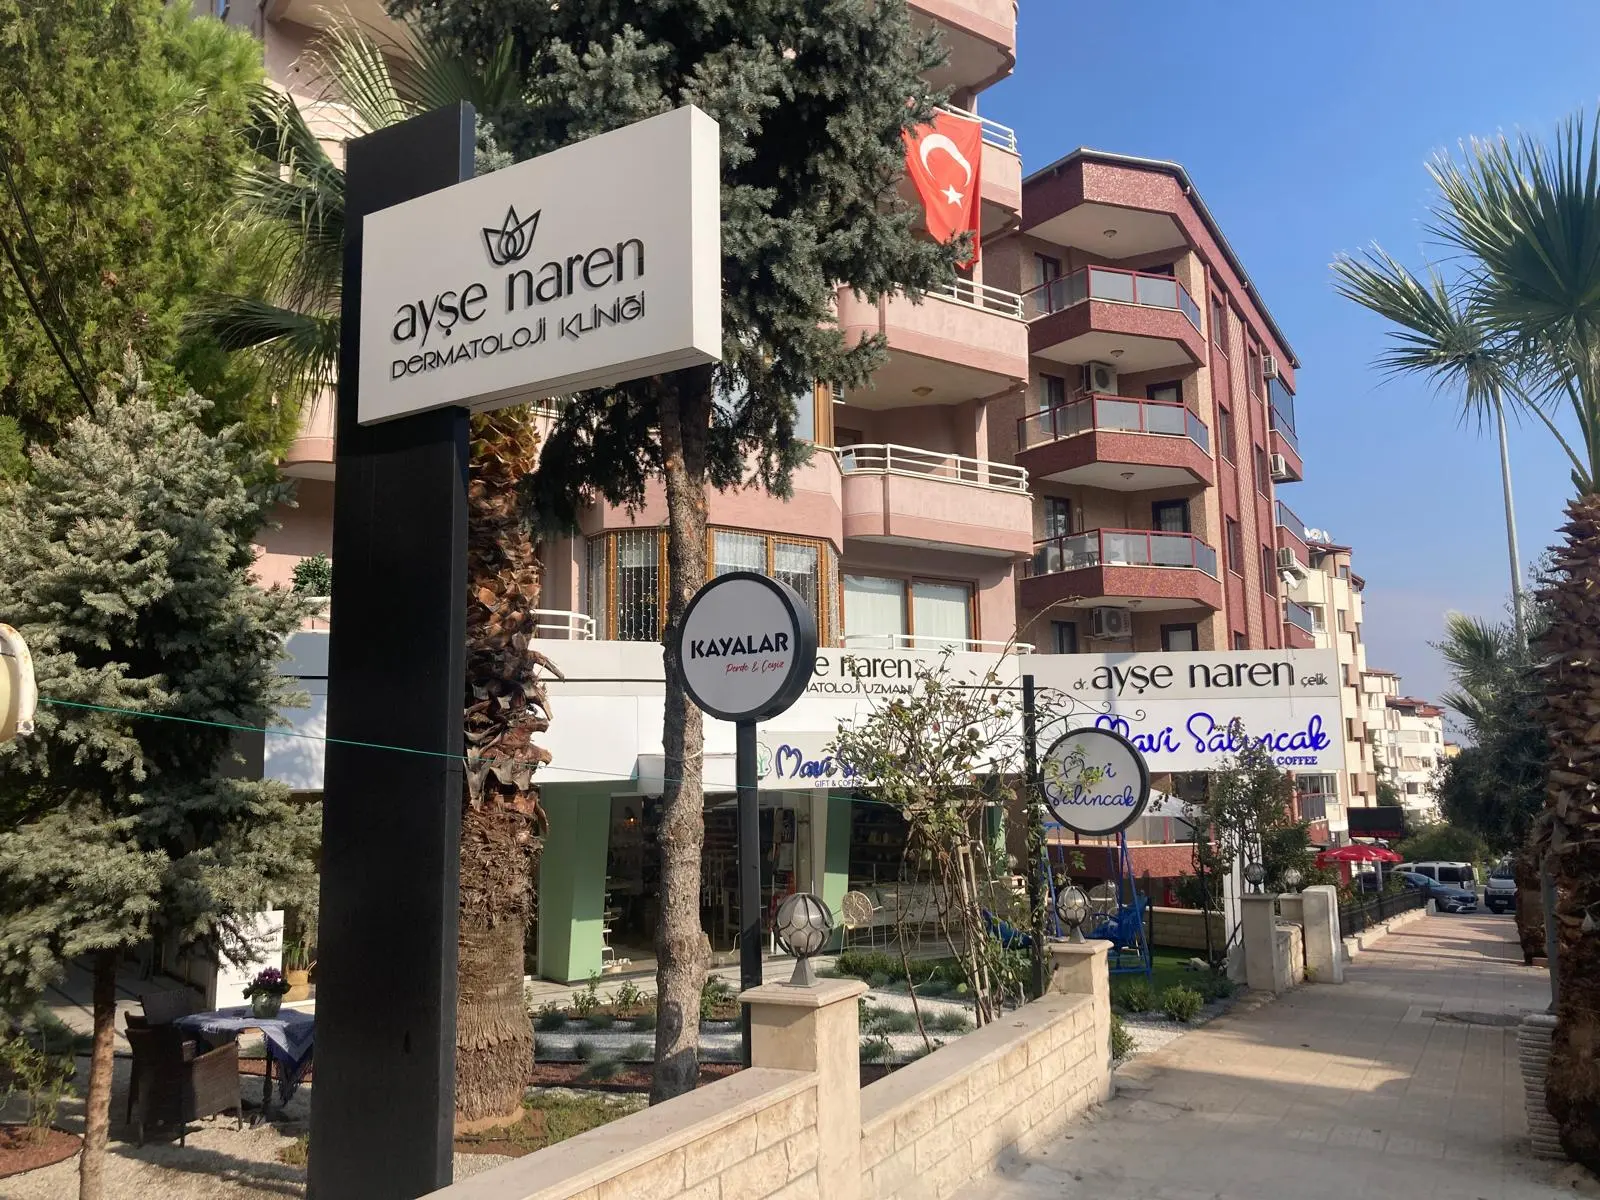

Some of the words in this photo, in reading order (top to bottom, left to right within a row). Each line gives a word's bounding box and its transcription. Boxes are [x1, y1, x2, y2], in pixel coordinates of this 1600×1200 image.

[393, 282, 488, 347] ayşe
[507, 237, 645, 312] naren
[691, 632, 789, 659] KAYALAR
[840, 656, 912, 679] naren
[1073, 678, 1089, 691] dr.
[1092, 664, 1174, 697] ayşe
[1189, 660, 1296, 689] naren
[1300, 672, 1329, 688] çelik
[1276, 755, 1318, 766] COFFEE
